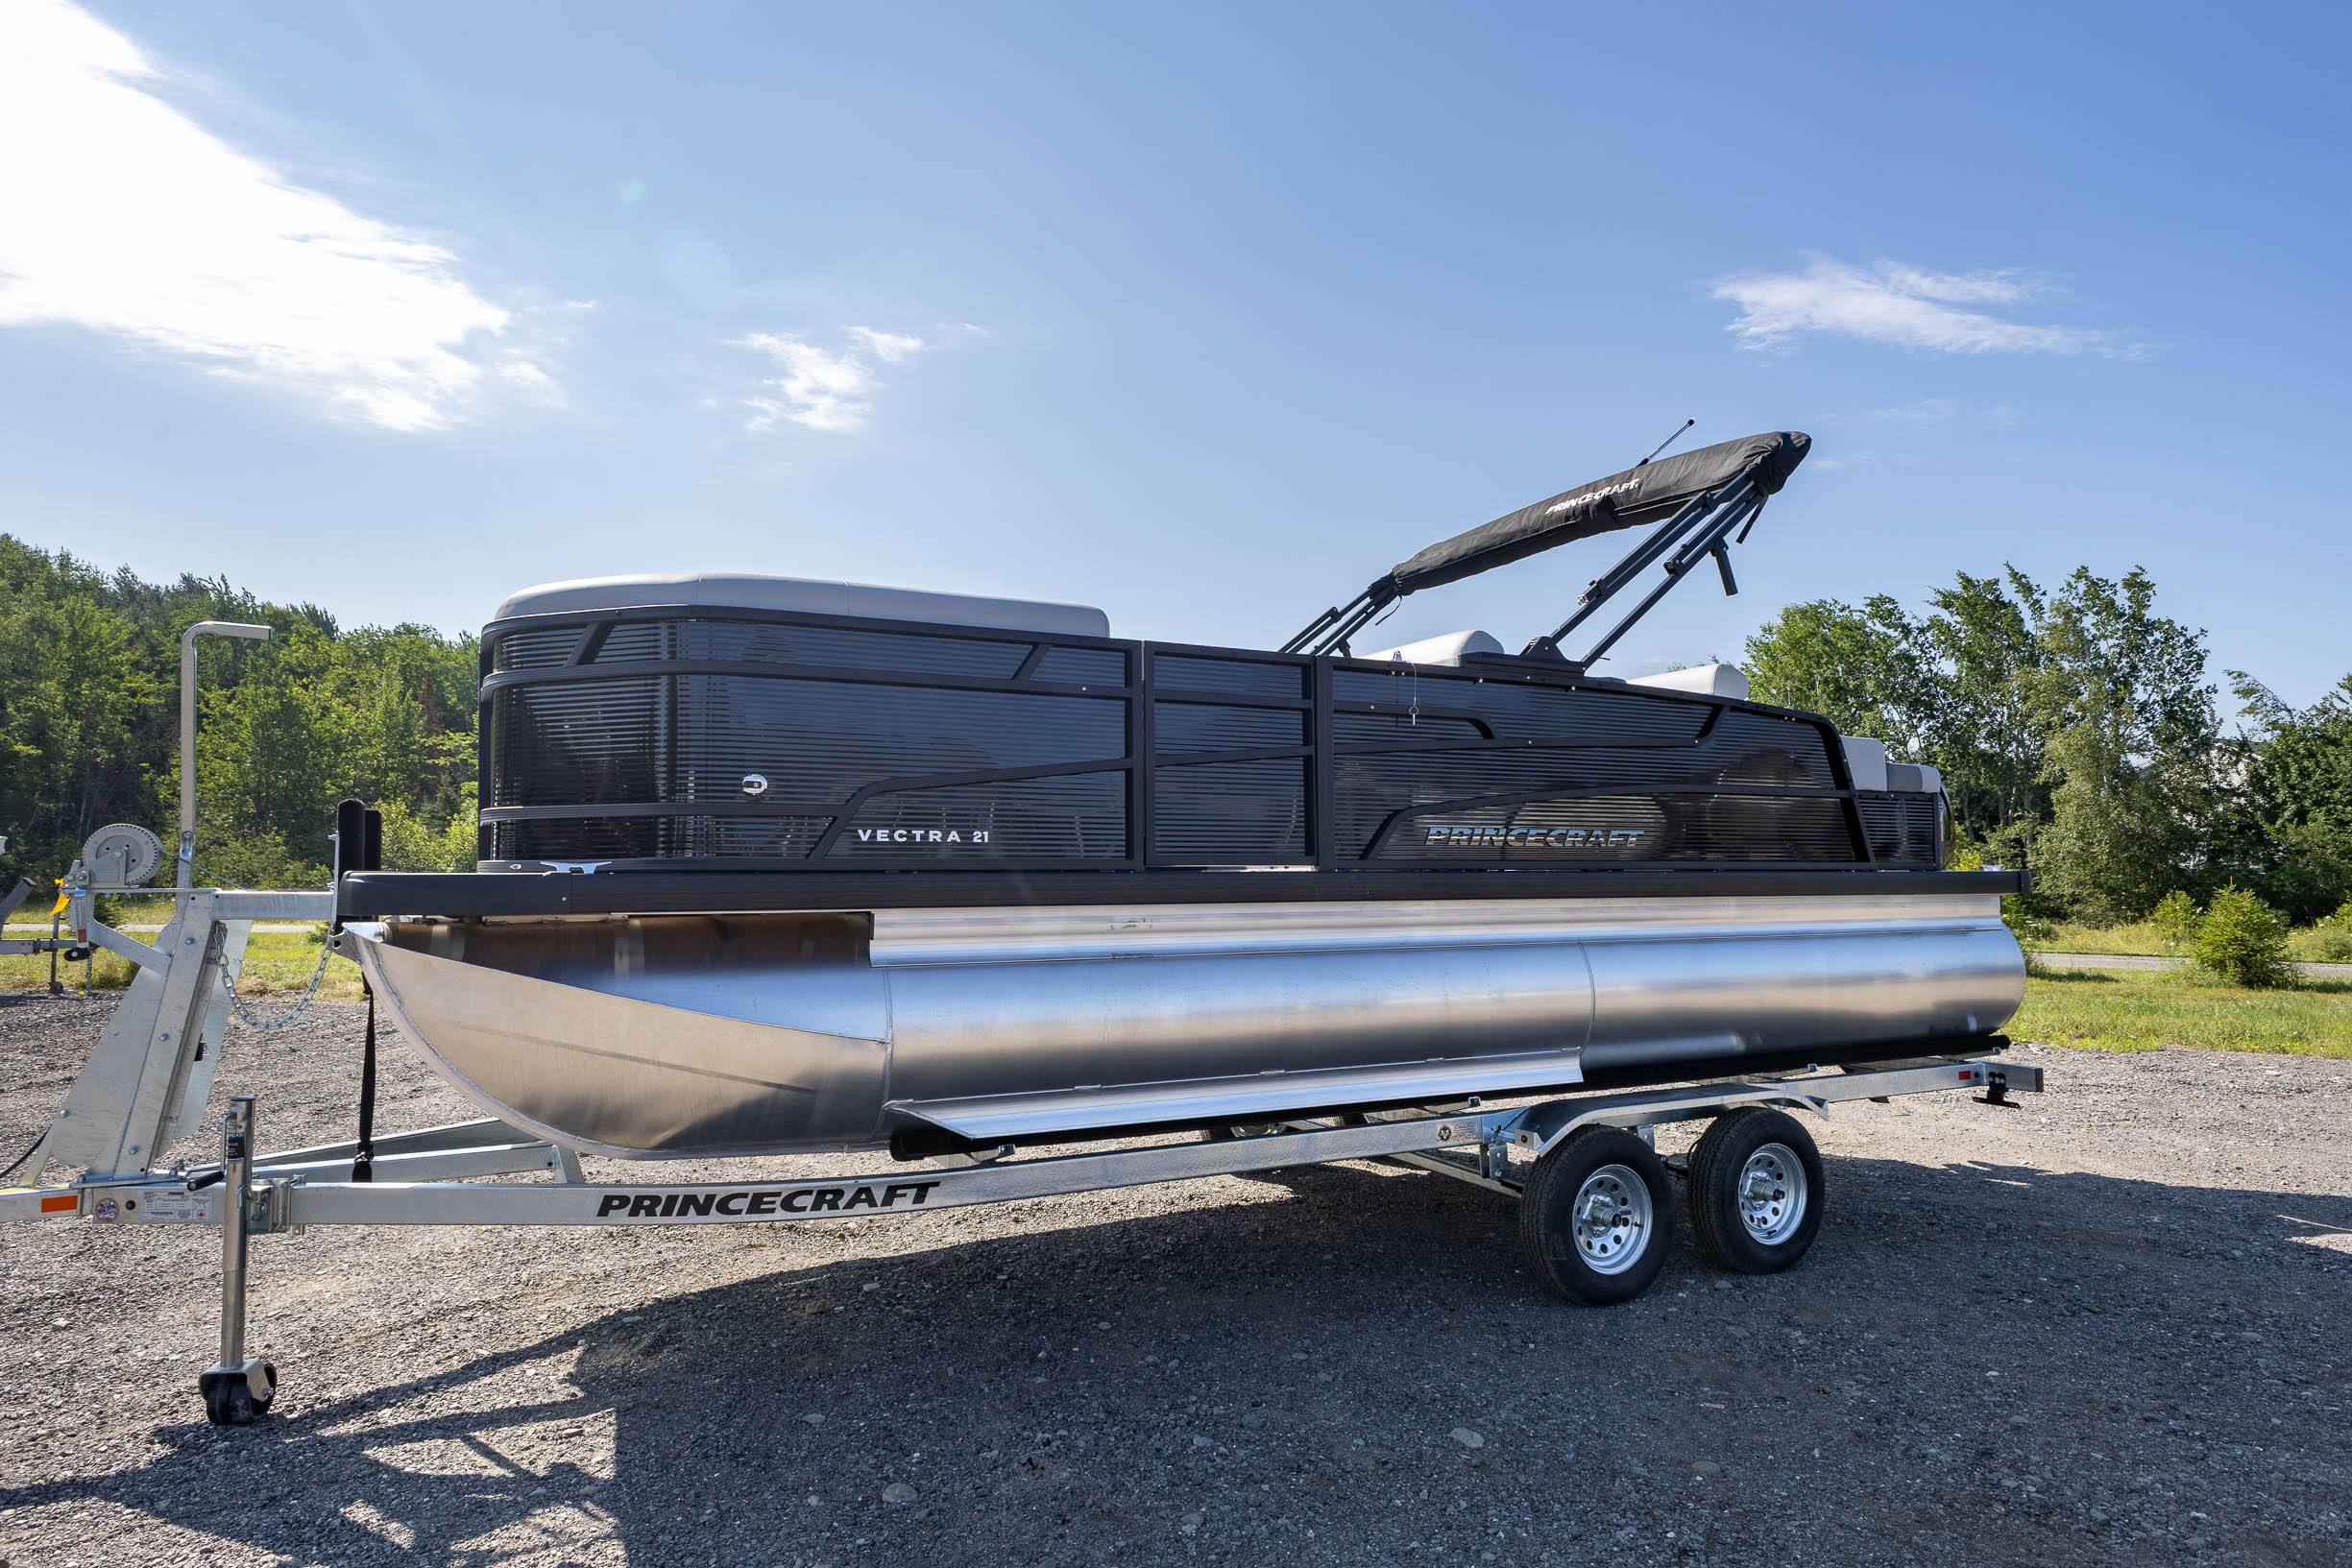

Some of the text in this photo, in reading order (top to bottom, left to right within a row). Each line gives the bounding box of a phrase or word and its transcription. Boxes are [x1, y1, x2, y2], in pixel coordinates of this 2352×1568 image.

[1544, 477, 1640, 515] PRINCECRAFT
[857, 829, 989, 843] VECTRA 21
[1424, 827, 1644, 847] PRINCECRAFT
[595, 1181, 941, 1218] PRINCECRAFT
